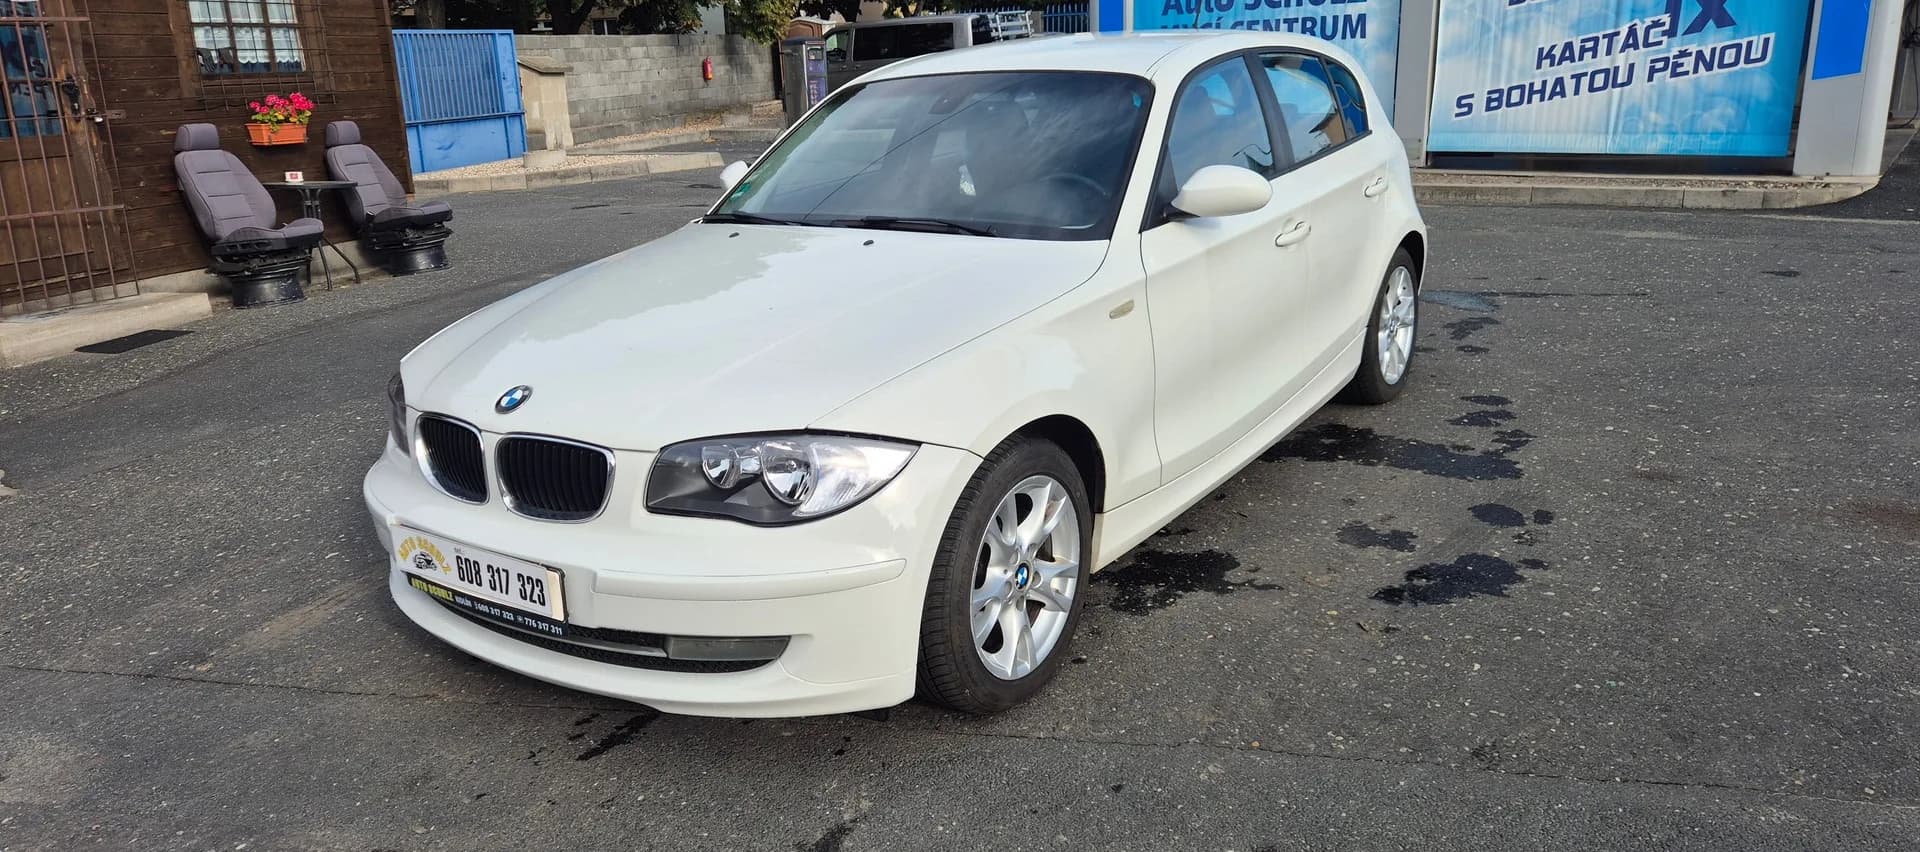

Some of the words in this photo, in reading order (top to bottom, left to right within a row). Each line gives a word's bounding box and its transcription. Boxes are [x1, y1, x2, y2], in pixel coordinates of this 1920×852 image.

[1536, 18, 1667, 70] KARTÁČ
[1454, 93, 1475, 118] S
[1484, 62, 1635, 112] BOHATOU
[1647, 37, 1771, 83] PĚNOU
[456, 555, 482, 587] 608
[487, 564, 509, 595] 317
[517, 573, 546, 607] 323
